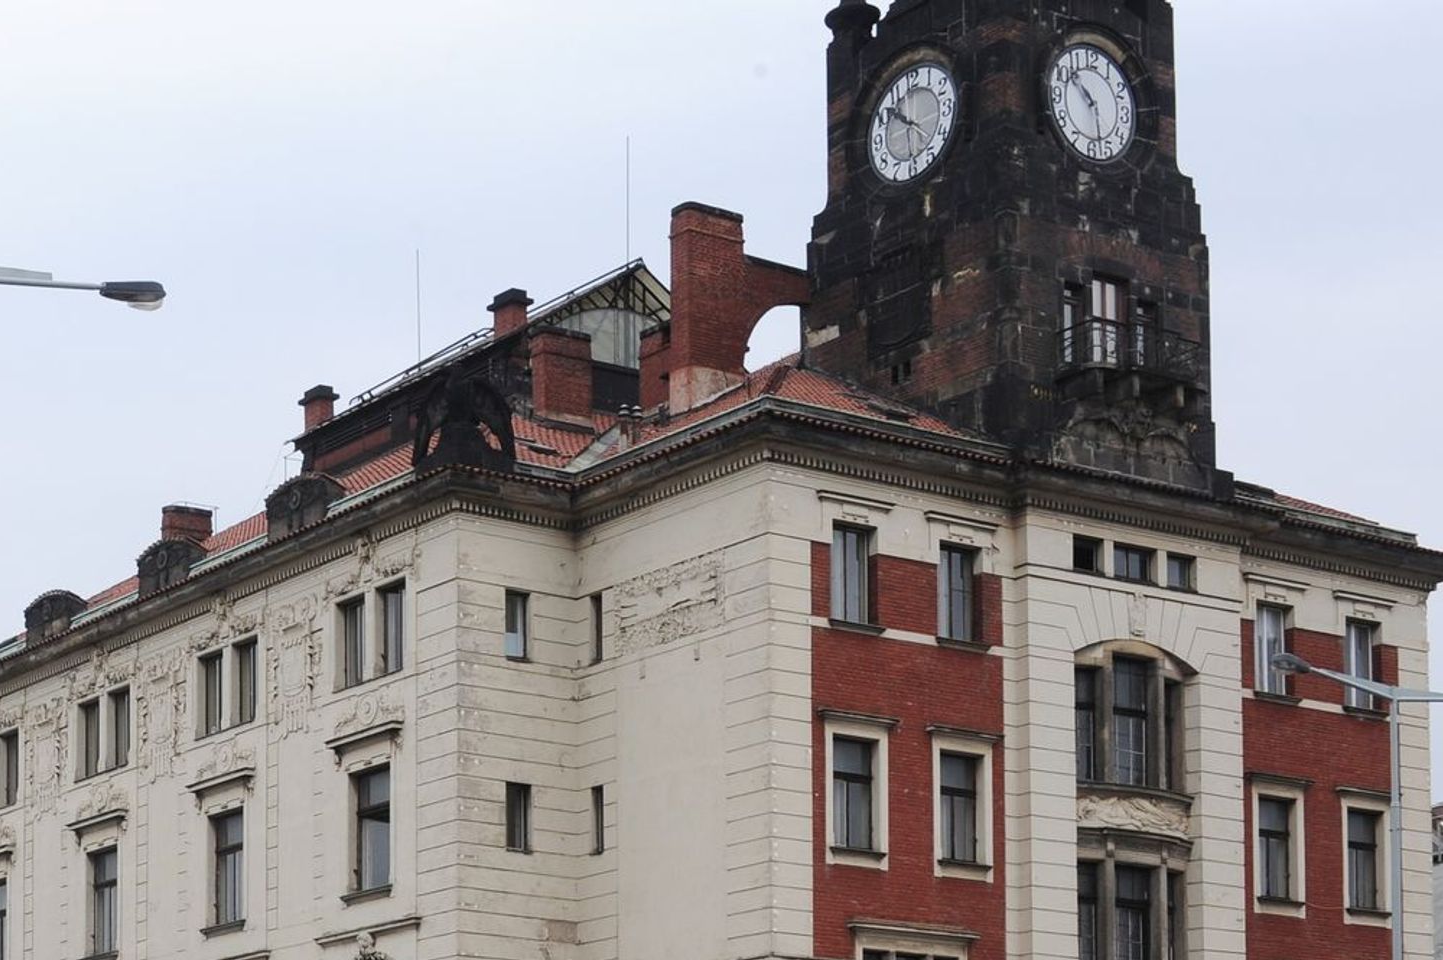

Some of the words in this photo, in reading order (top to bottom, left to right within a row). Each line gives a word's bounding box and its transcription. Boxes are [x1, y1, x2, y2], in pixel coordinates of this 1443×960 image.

[1085, 50, 1098, 70] 12
[927, 67, 931, 86] 1
[1056, 64, 1069, 83] 10
[1105, 61, 1110, 80] 1
[906, 70, 920, 92] 12
[938, 77, 948, 96] 2
[1116, 81, 1126, 100] 2
[1053, 86, 1062, 104] 9
[942, 98, 952, 117] 3
[1120, 105, 1129, 124] 3
[1058, 109, 1067, 128] 8
[937, 123, 947, 140] 4
[1071, 130, 1080, 148] 7
[1116, 126, 1124, 145] 4
[874, 133, 883, 152] 9
[1087, 140, 1096, 159] 6
[1103, 140, 1113, 159] 5
[879, 151, 888, 171] 8
[893, 161, 901, 181] 7
